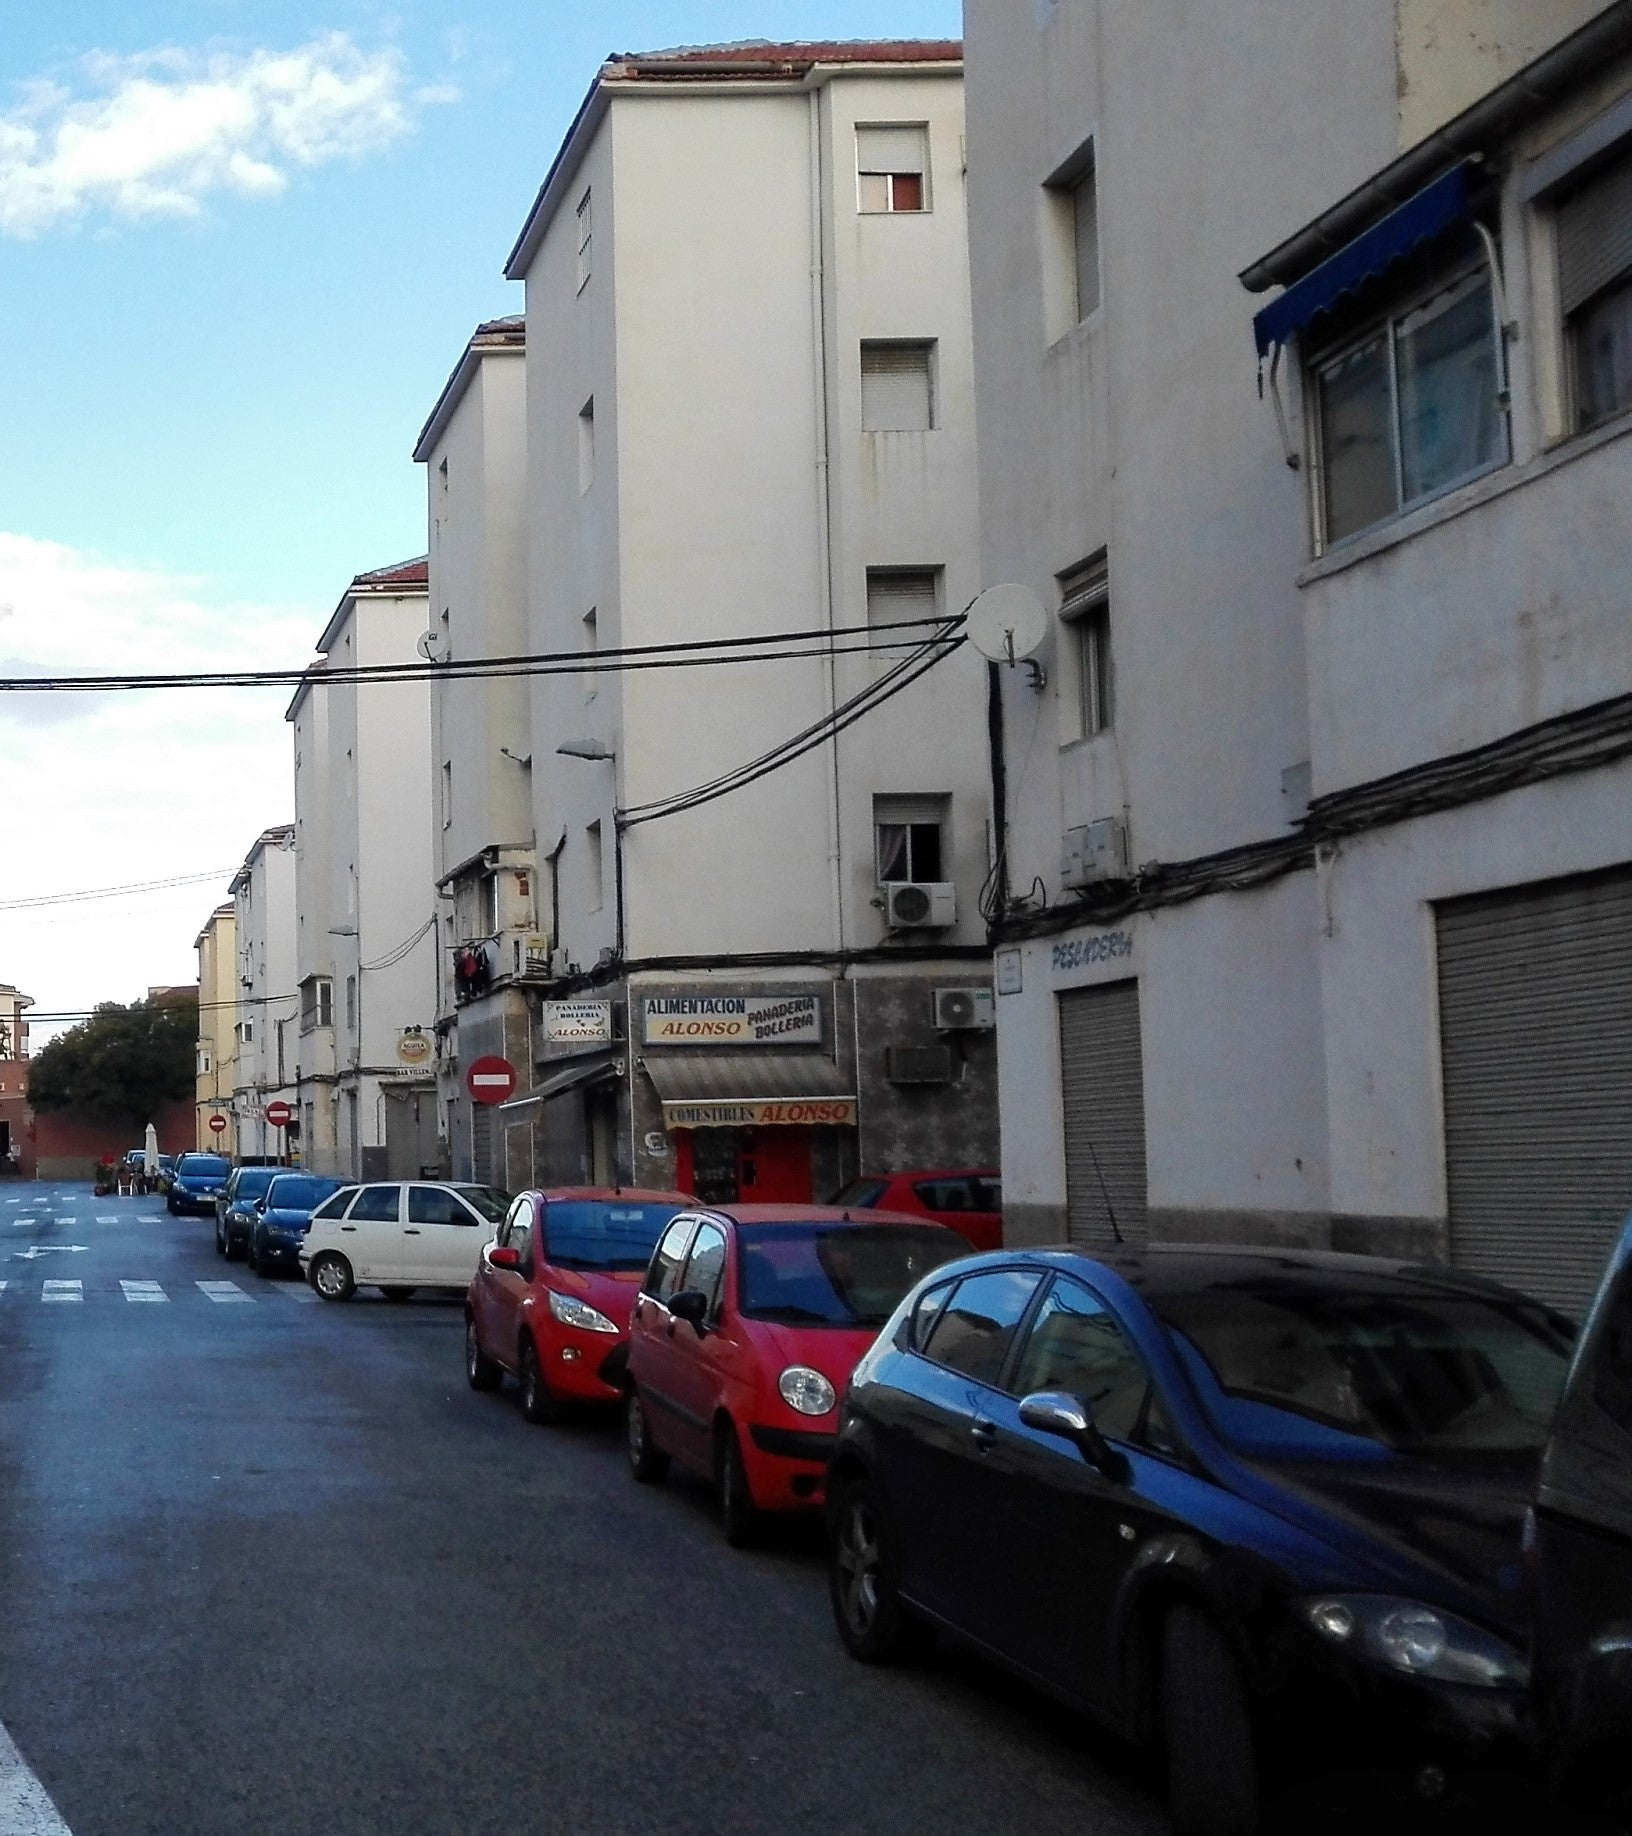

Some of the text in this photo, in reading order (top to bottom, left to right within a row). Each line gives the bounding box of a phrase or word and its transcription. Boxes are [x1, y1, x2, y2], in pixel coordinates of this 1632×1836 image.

[556, 1003, 602, 1011] PANADERIA
[647, 998, 746, 1014] ALIMENTACION
[747, 997, 815, 1025] PANADERIA
[560, 1011, 599, 1019] BOLLERIA
[553, 1028, 606, 1036] ALONSO
[661, 1021, 742, 1036] ALONSO
[754, 1013, 814, 1039] BOLLERIA
[669, 1102, 850, 1123] COMESTIBLES ALONSO
